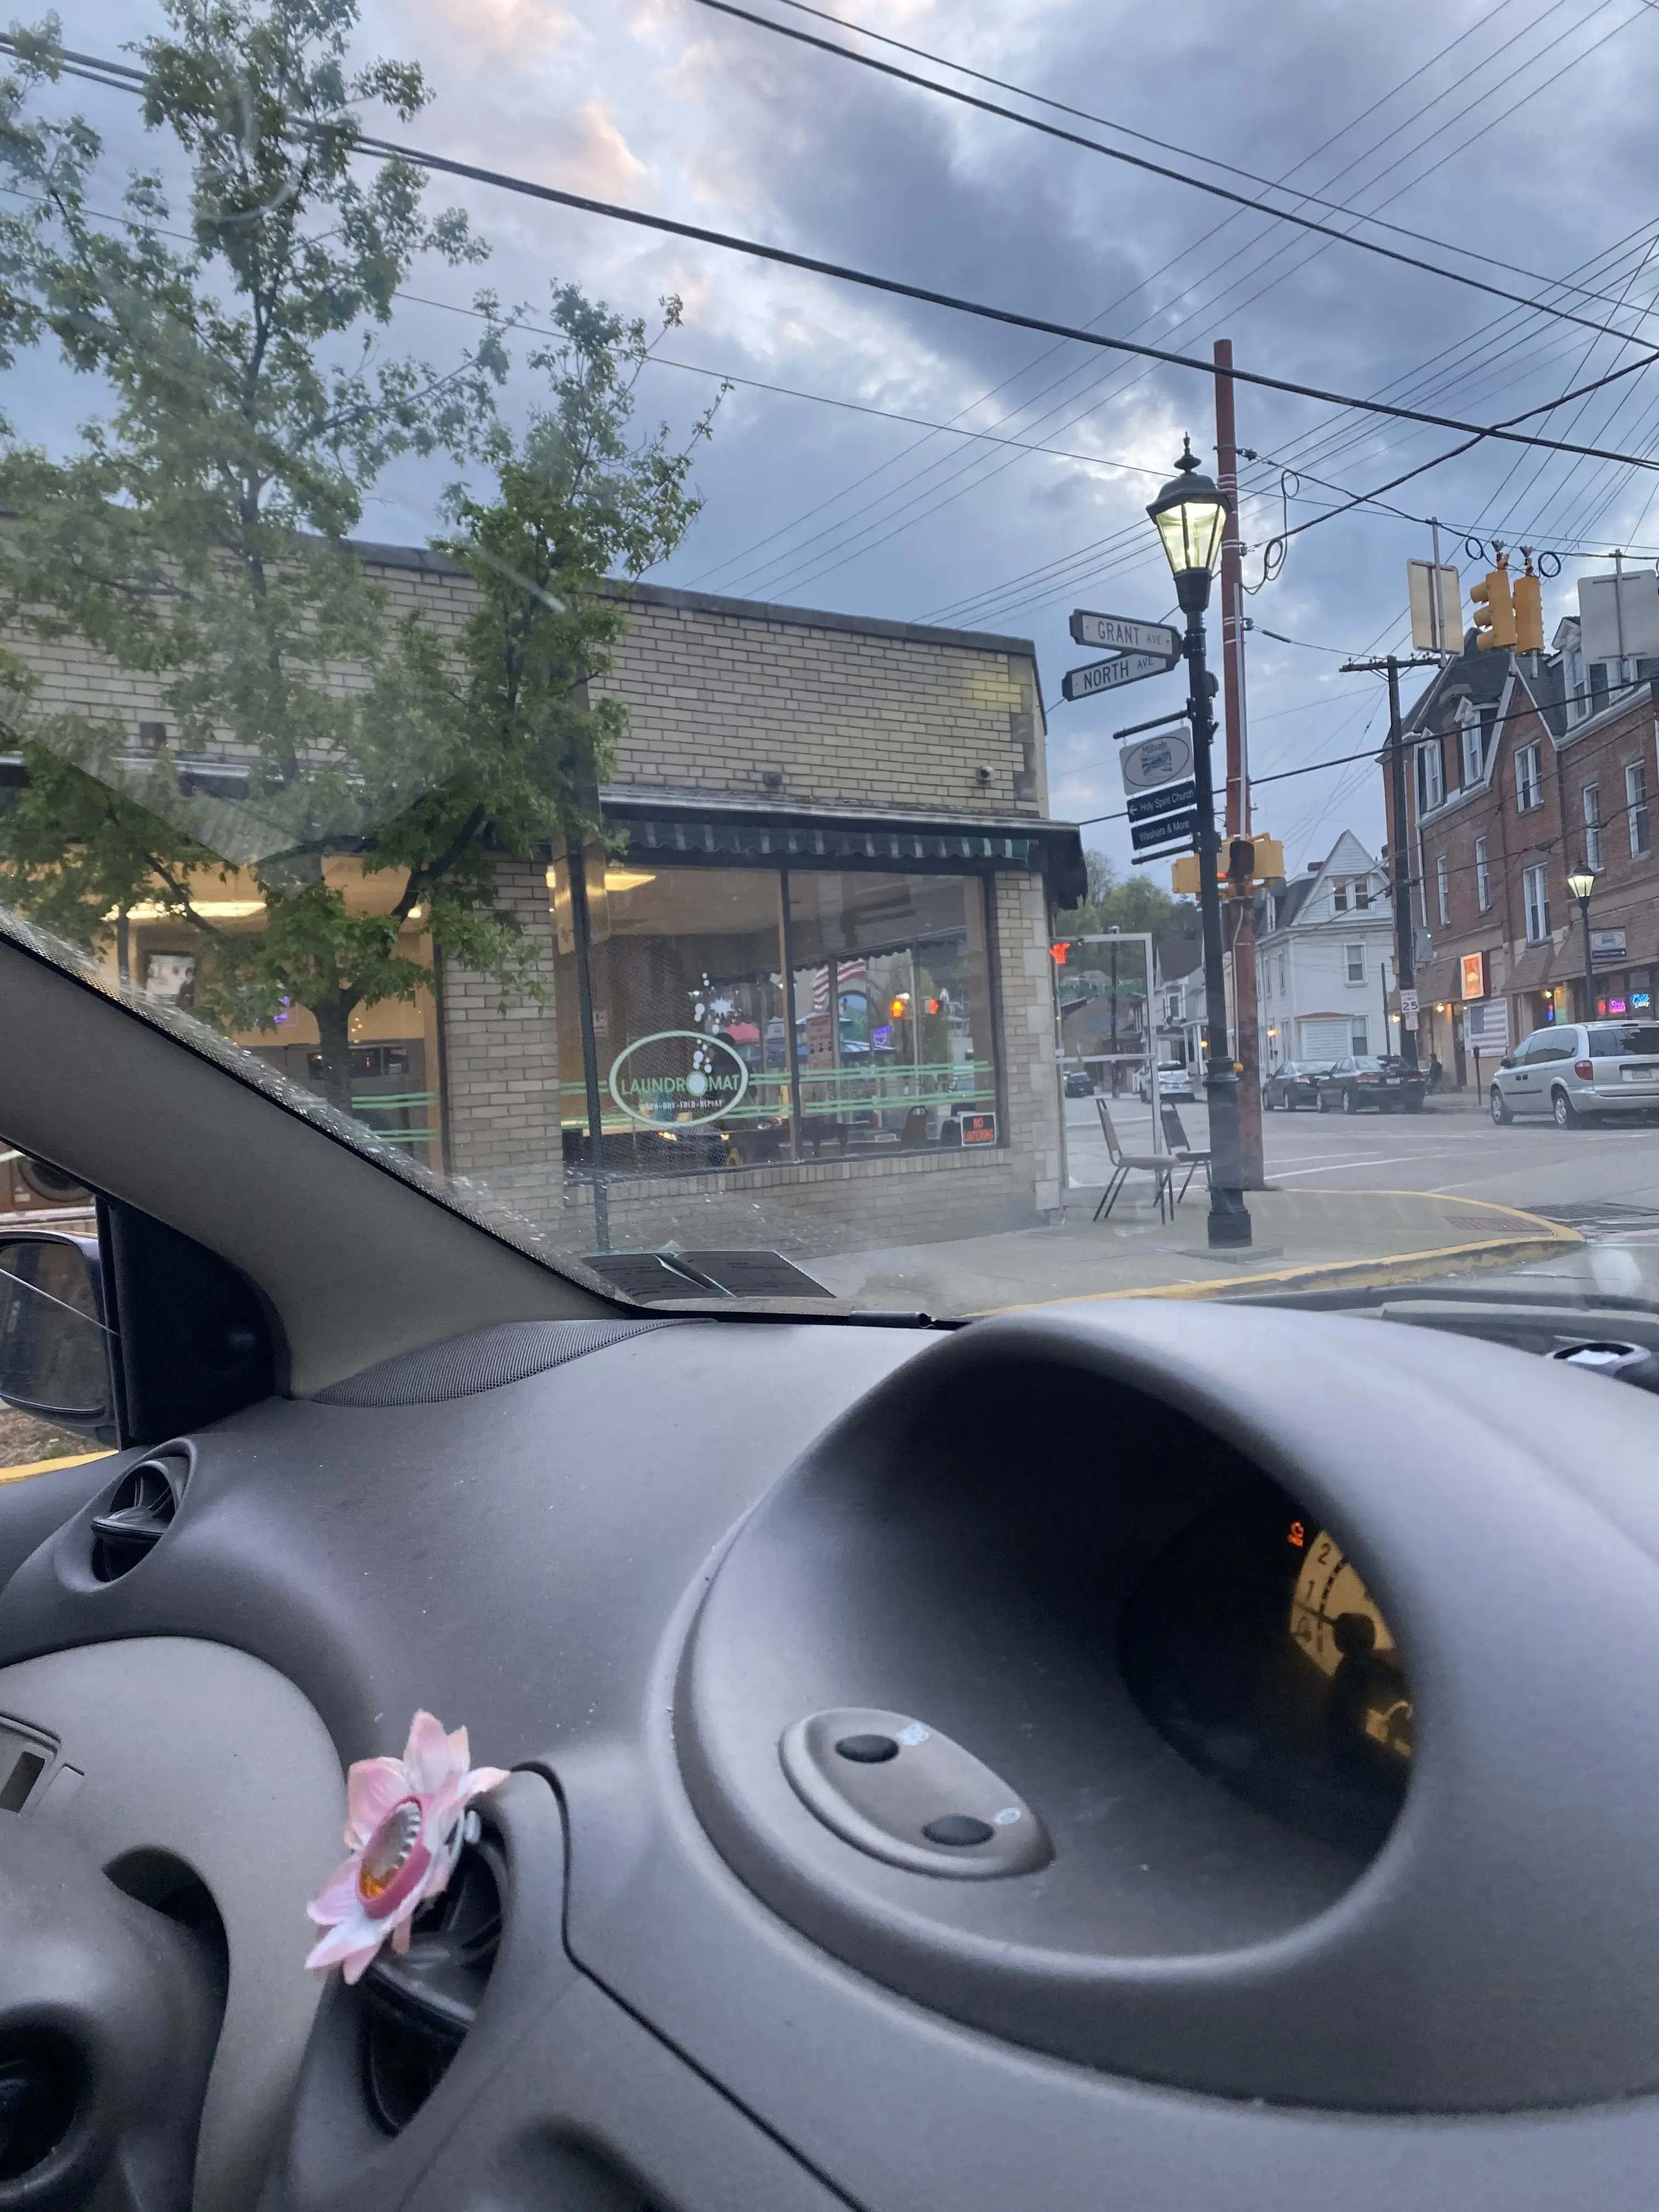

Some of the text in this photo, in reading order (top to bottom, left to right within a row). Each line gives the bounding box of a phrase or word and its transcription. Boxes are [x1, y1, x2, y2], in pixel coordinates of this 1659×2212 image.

[1097, 619, 1162, 646] GRANT AVE
[1084, 657, 1154, 690] NORTH AVE
[1141, 741, 1168, 754] Millvale
[1139, 788, 1194, 812] Holy Spirit Church
[1139, 820, 1190, 843] Washers & More
[1402, 1001, 1418, 1011] 25
[620, 1072, 740, 1096] LAUNDROMAT
[973, 1117, 984, 1129] NO
[1317, 1542, 1330, 1566] 2
[1306, 1579, 1316, 1602] 1
